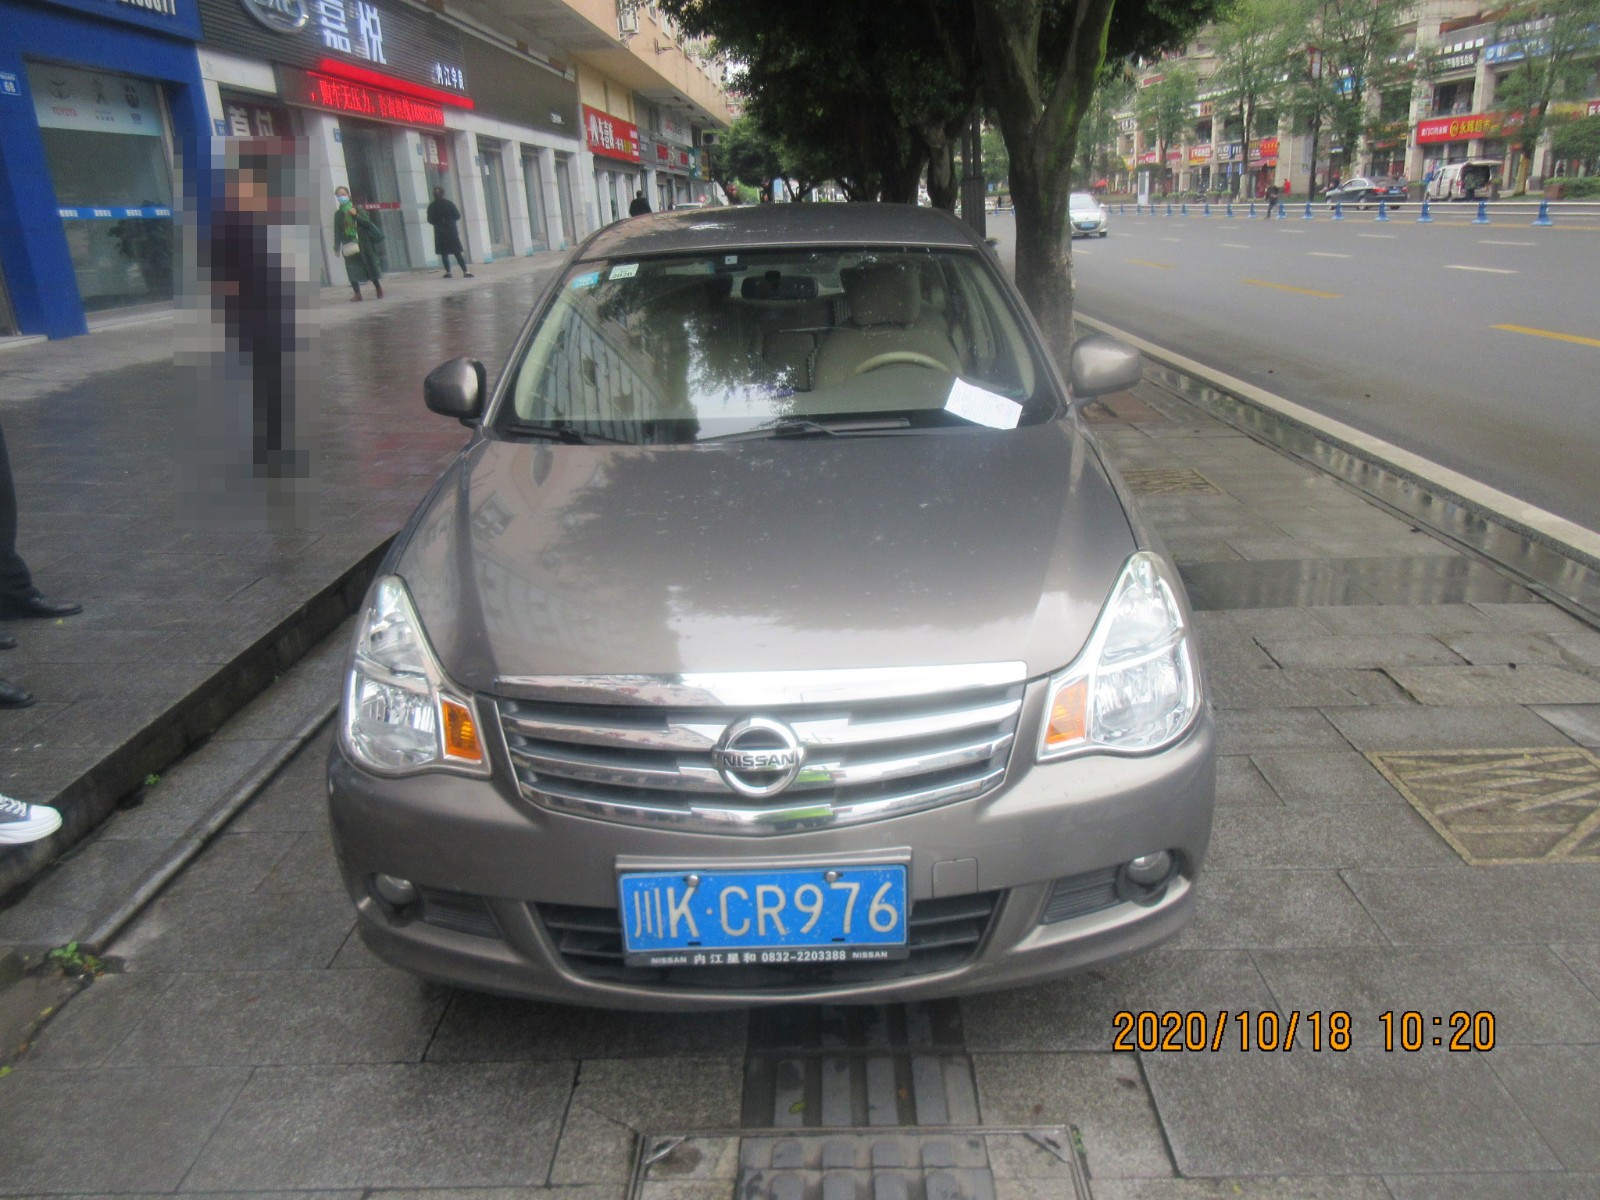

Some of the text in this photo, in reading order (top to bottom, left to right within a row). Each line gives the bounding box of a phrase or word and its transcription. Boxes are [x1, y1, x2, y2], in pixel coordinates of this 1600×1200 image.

[722, 753, 795, 767] NISSAN
[761, 951, 847, 963] 0832-2203388
[852, 950, 888, 959] NISSAN
